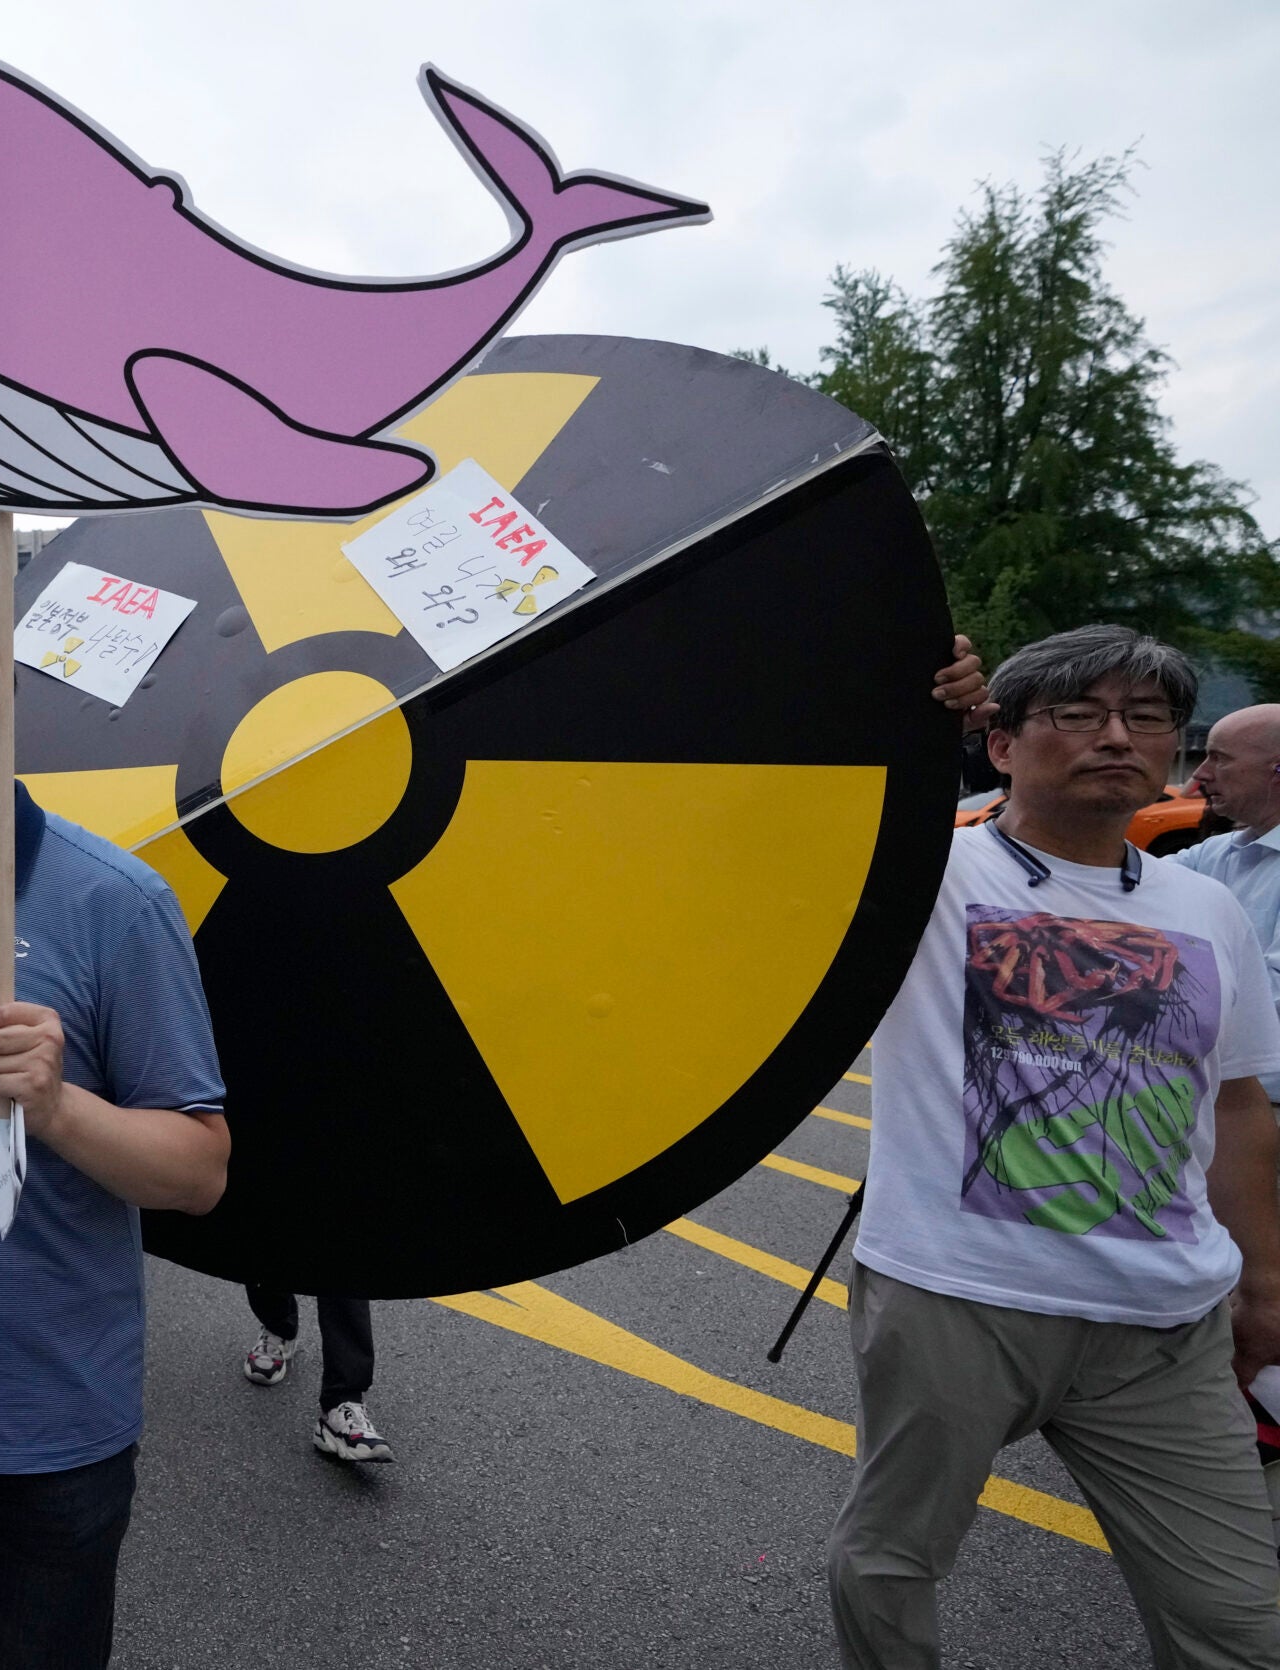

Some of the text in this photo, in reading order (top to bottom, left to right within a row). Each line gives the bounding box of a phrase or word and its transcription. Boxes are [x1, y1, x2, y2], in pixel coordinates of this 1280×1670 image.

[469, 496, 548, 566] IAEA
[385, 547, 428, 578] 왜
[86, 576, 159, 620] IAEA
[982, 1076, 1197, 1236] STOP
